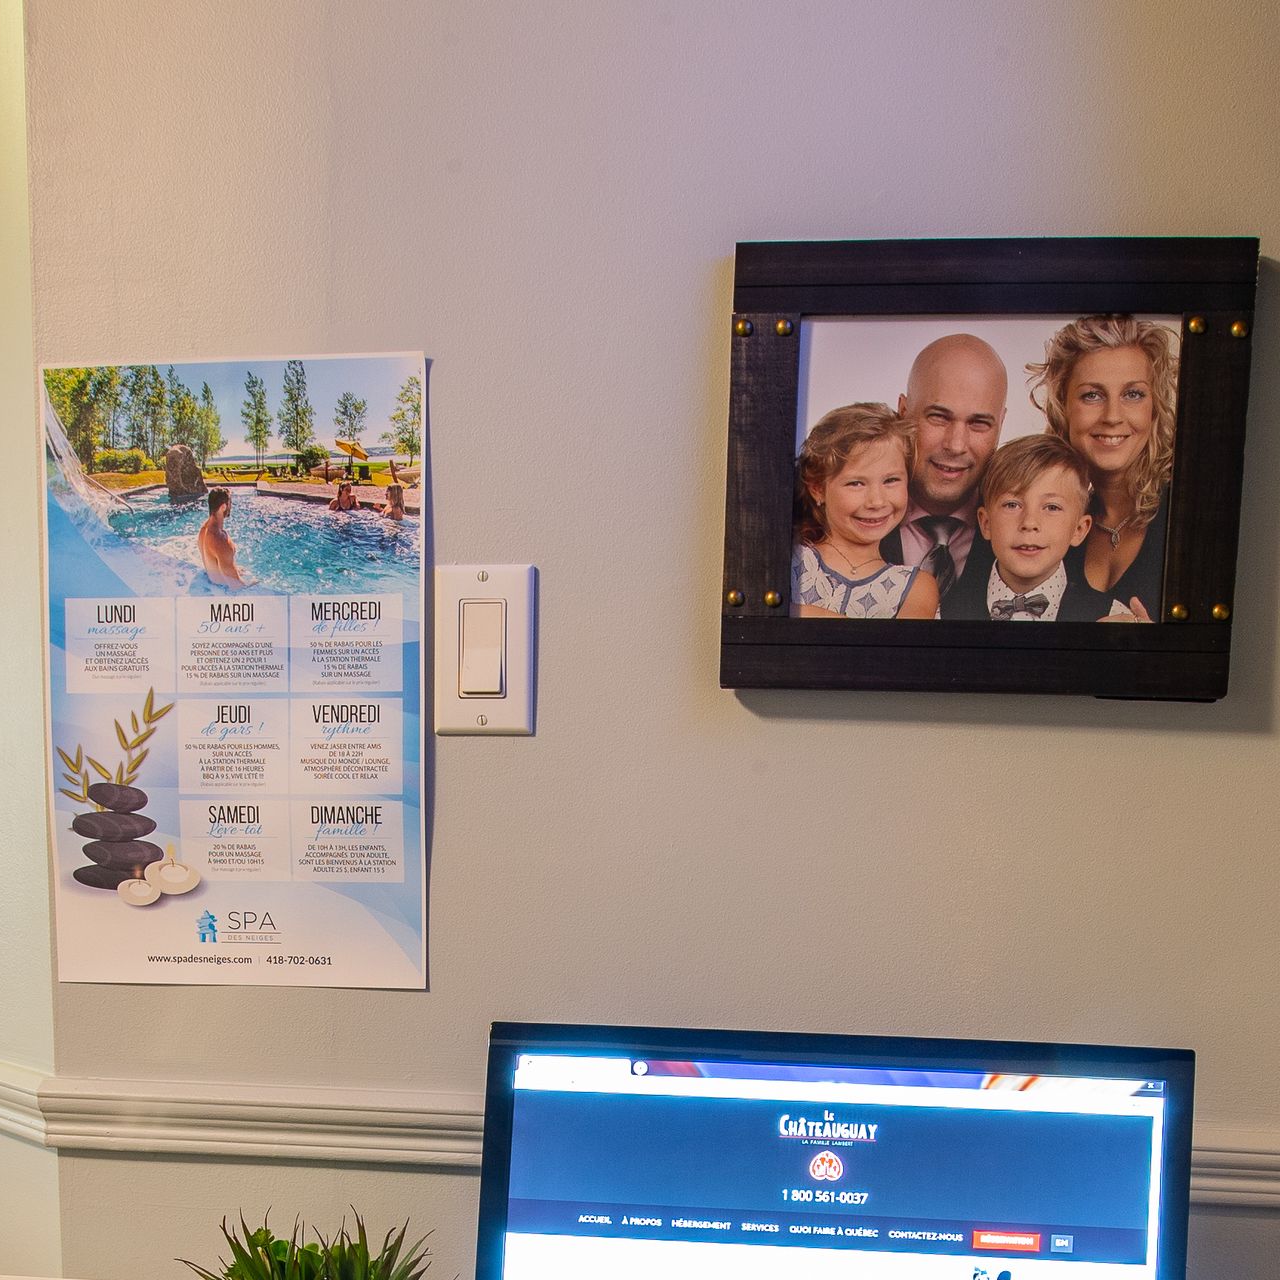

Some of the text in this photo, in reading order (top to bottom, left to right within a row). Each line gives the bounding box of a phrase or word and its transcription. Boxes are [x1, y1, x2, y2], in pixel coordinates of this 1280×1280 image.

[97, 605, 135, 623] LUNDI
[211, 604, 253, 622] MARDI
[312, 601, 380, 620] MERCREDI
[88, 626, 146, 640] massage
[197, 622, 221, 633] 50
[225, 624, 251, 633] ans
[312, 620, 327, 634] de
[330, 619, 368, 638] filles
[215, 706, 250, 723] JEUDI
[313, 705, 380, 723] VENDREDI
[201, 722, 216, 736] de
[219, 726, 253, 741] gars
[209, 806, 259, 823] SAMEDI
[311, 806, 382, 824] DIMANCHE
[315, 823, 367, 841] famille
[228, 911, 277, 930] SPA
[148, 955, 332, 966] www.spadesneiges.com 418-702-0631
[780, 1114, 878, 1139] CHÂTEAUGUAY
[782, 1189, 868, 1204] 1 800 561-0037
[578, 1215, 612, 1224] ACCUEIL
[630, 1217, 662, 1226] PROPOS
[741, 1223, 779, 1233] SERVICES
[789, 1226, 811, 1234] QUOI
[889, 1230, 963, 1242] CONTACTEZ-NOUS
